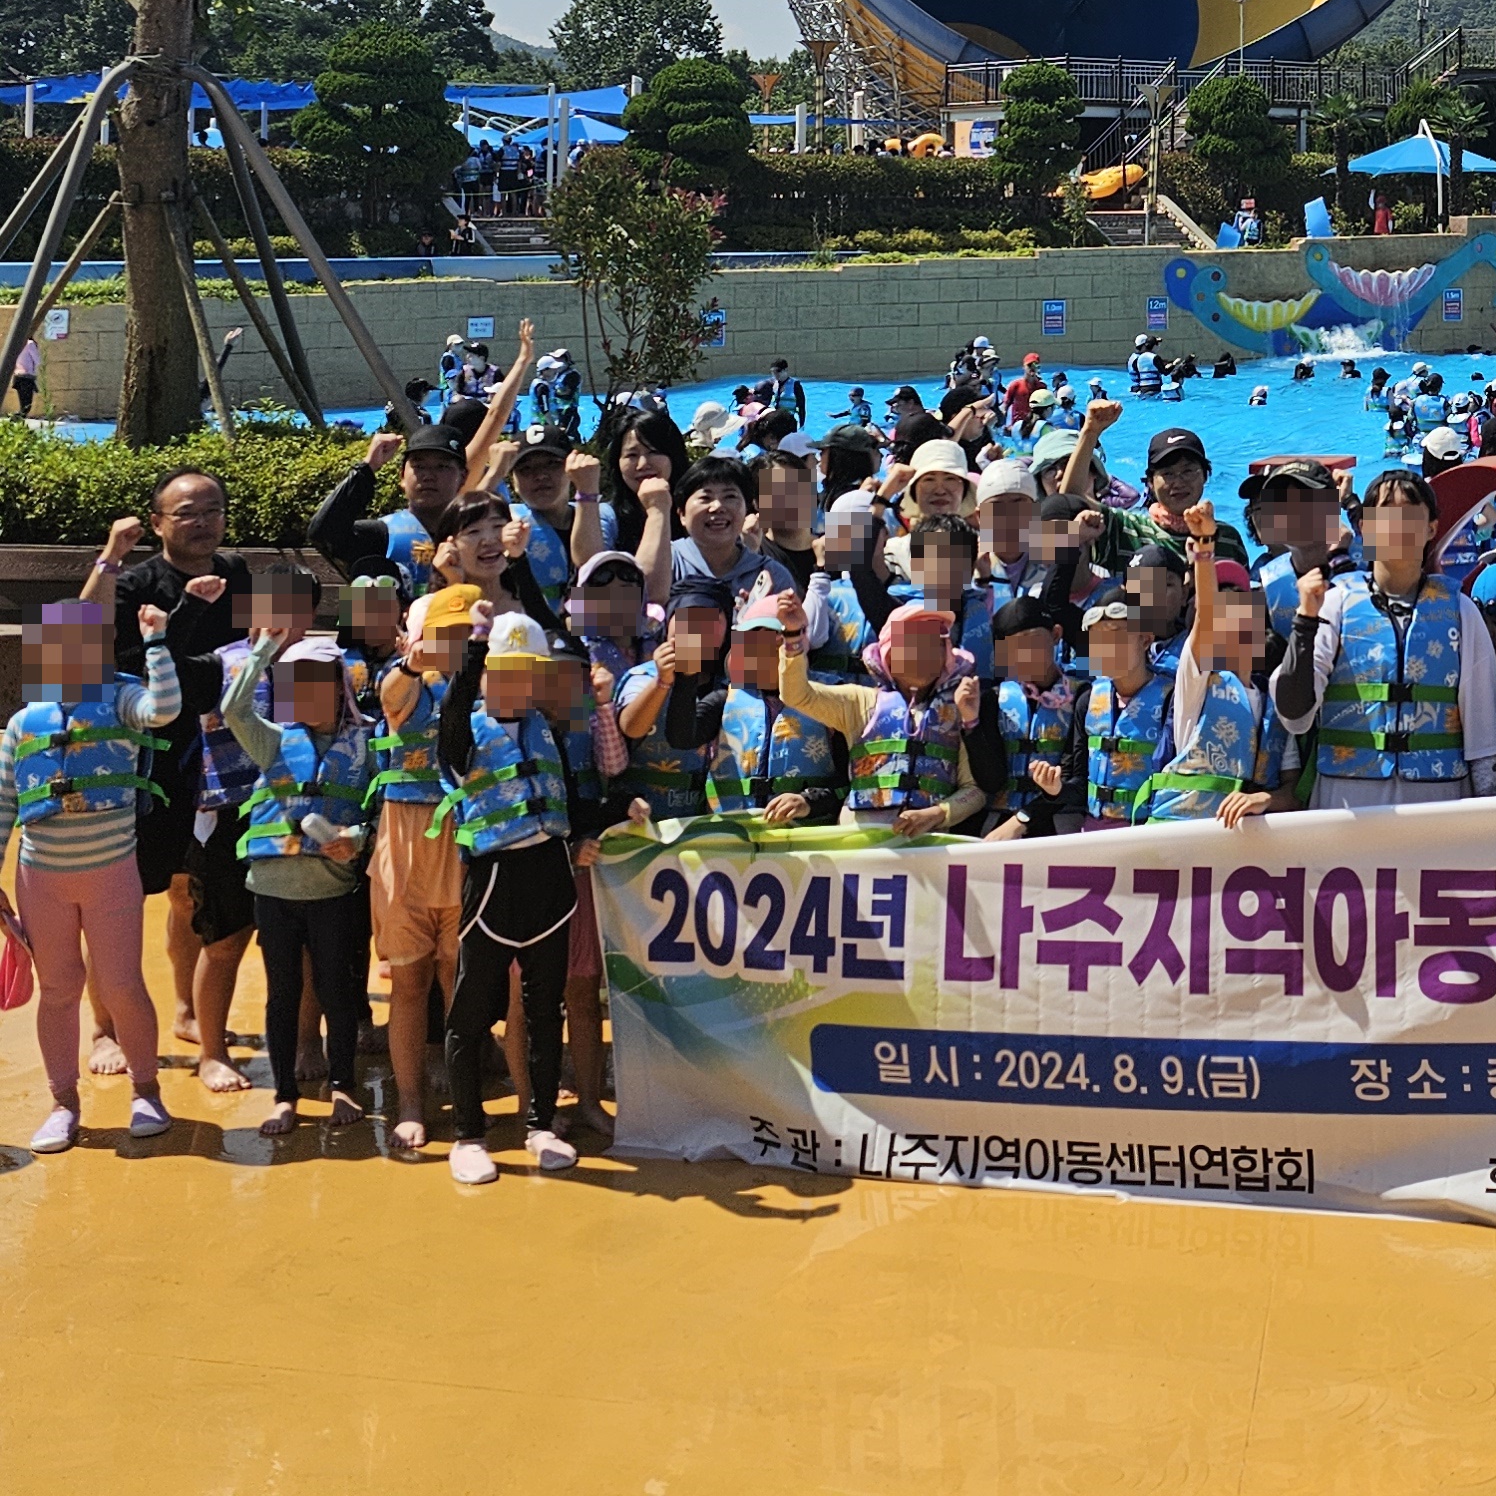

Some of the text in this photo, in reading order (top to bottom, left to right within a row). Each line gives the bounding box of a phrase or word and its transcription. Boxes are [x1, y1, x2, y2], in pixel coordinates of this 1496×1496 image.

[648, 866, 907, 981] 2024년
[874, 1041, 911, 1084] 일
[925, 1044, 960, 1086] 시
[996, 1049, 1099, 1093] 2024.
[1113, 1054, 1152, 1095] 8.
[1162, 1054, 1260, 1099] 9.(금)
[1350, 1057, 1394, 1100] 장
[1408, 1058, 1447, 1099] 소
[858, 1131, 1315, 1195] 나주지역아동센터연합회
